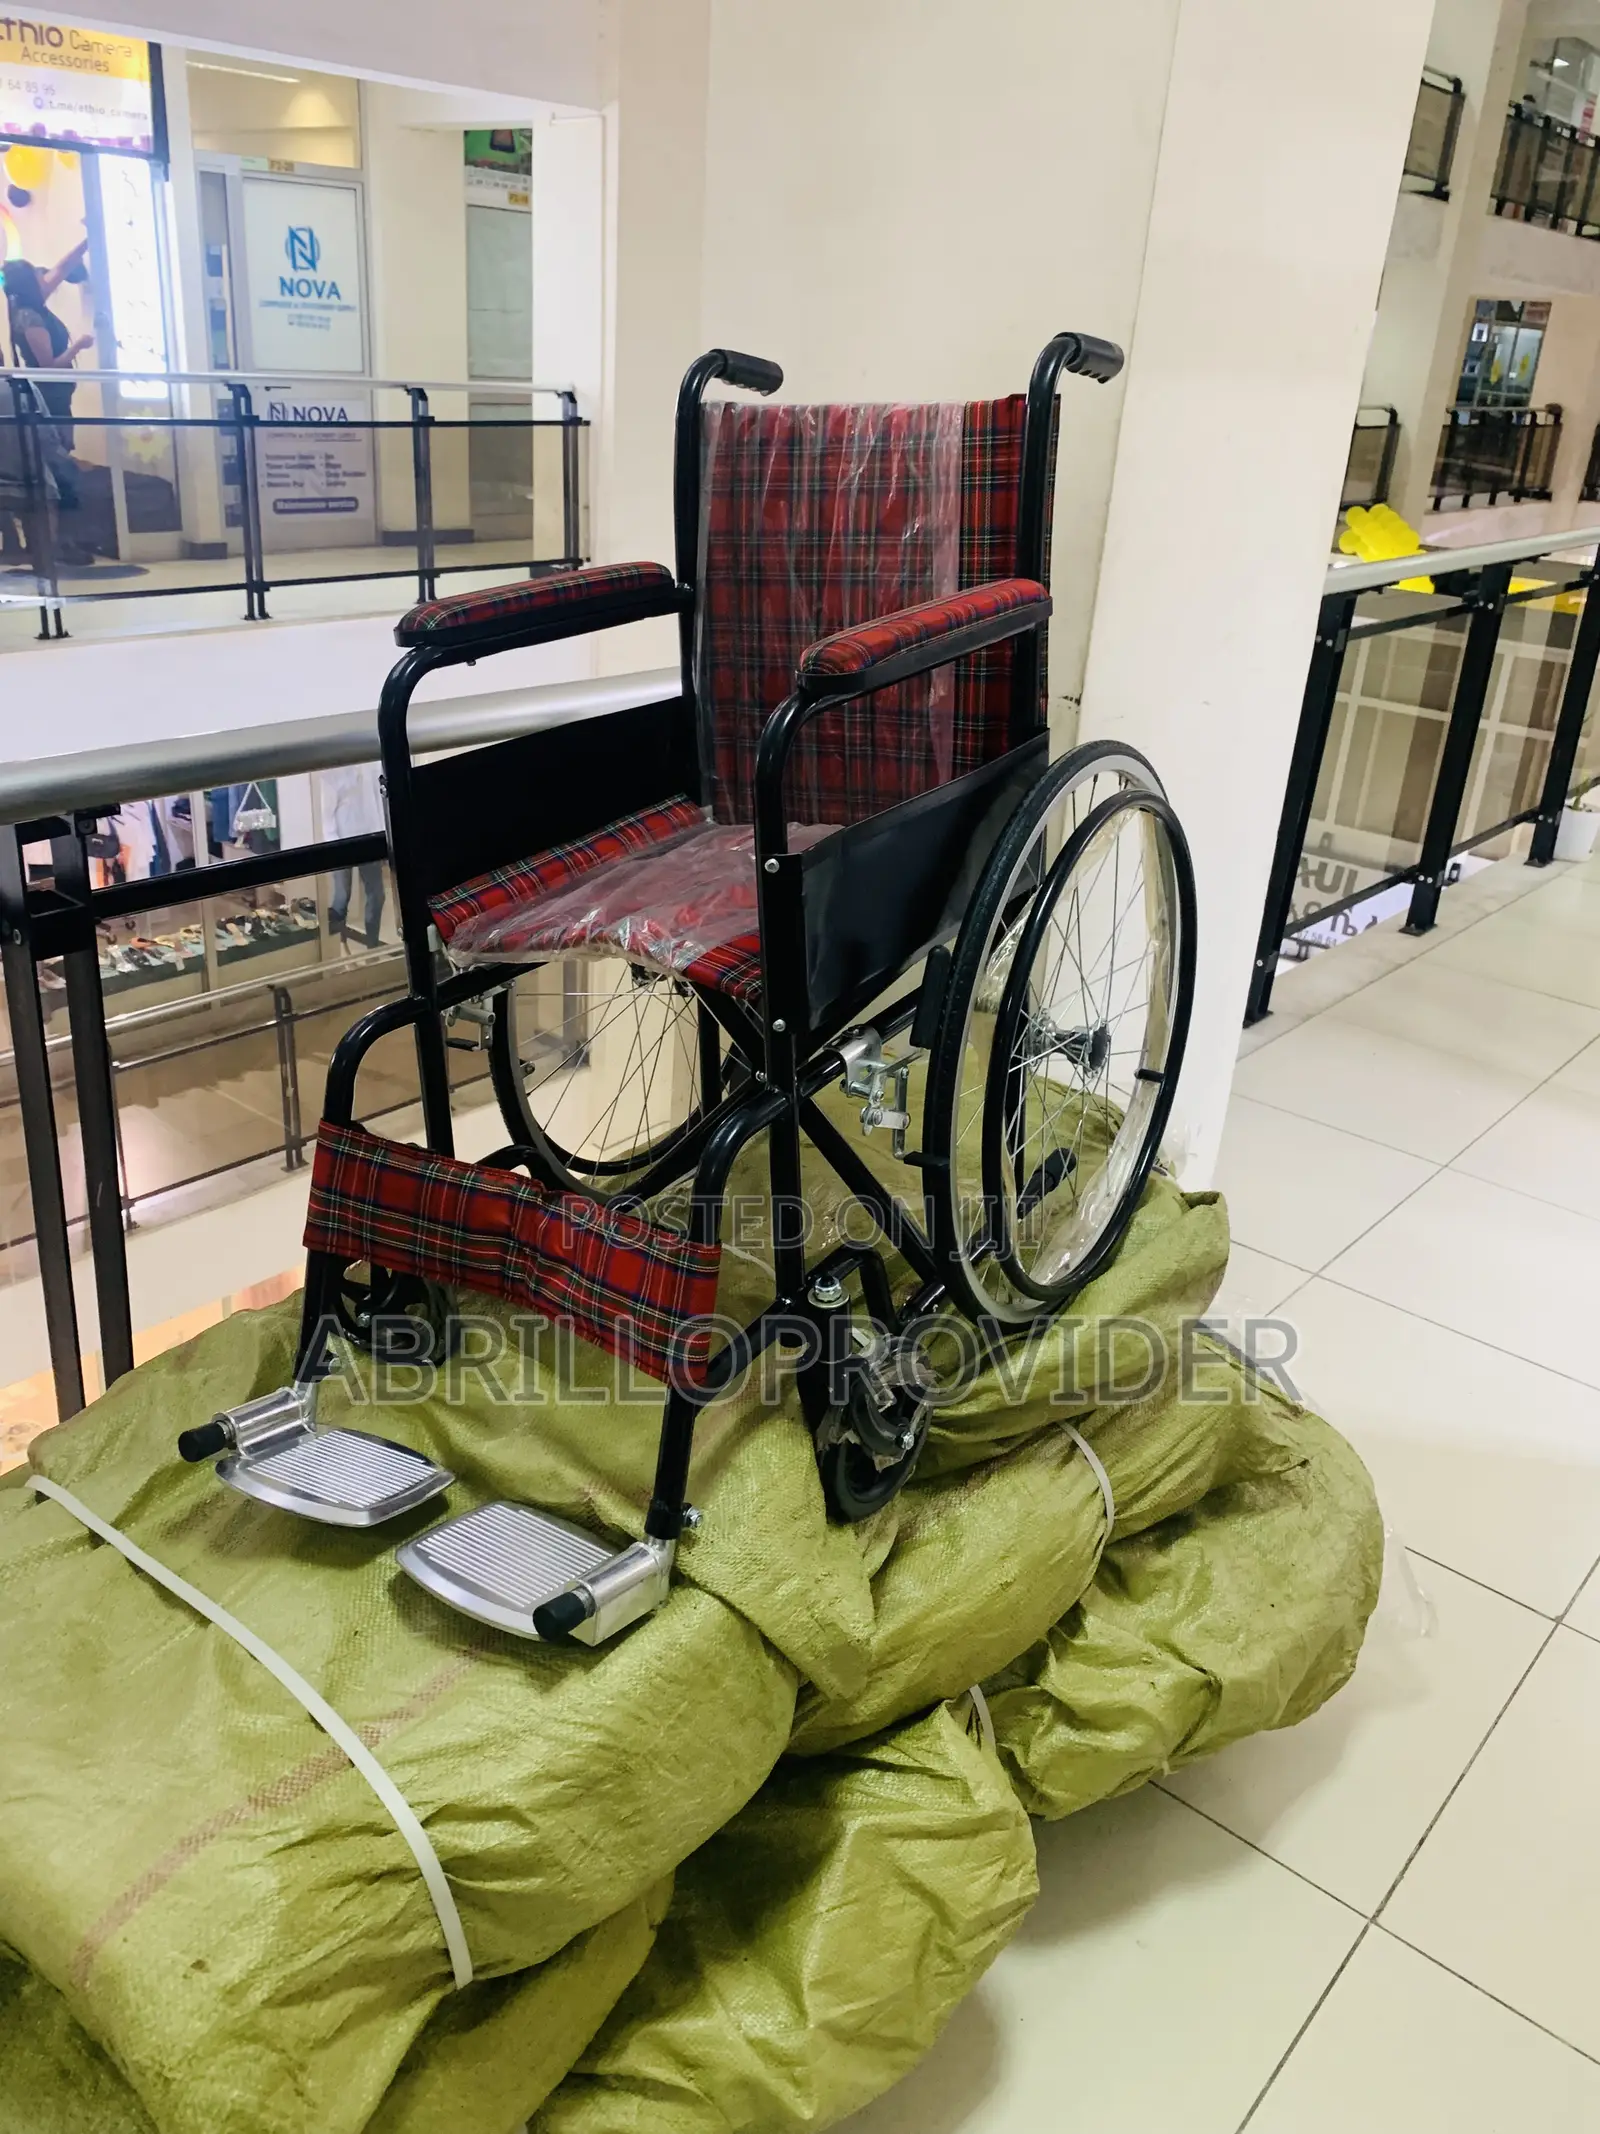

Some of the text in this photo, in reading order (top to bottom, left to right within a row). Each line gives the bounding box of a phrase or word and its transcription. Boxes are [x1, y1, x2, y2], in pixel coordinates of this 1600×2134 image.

[69, 29, 132, 58] Camera
[20, 45, 110, 73] Accessories
[278, 275, 342, 301] NOVA
[292, 405, 349, 423] NOVA
